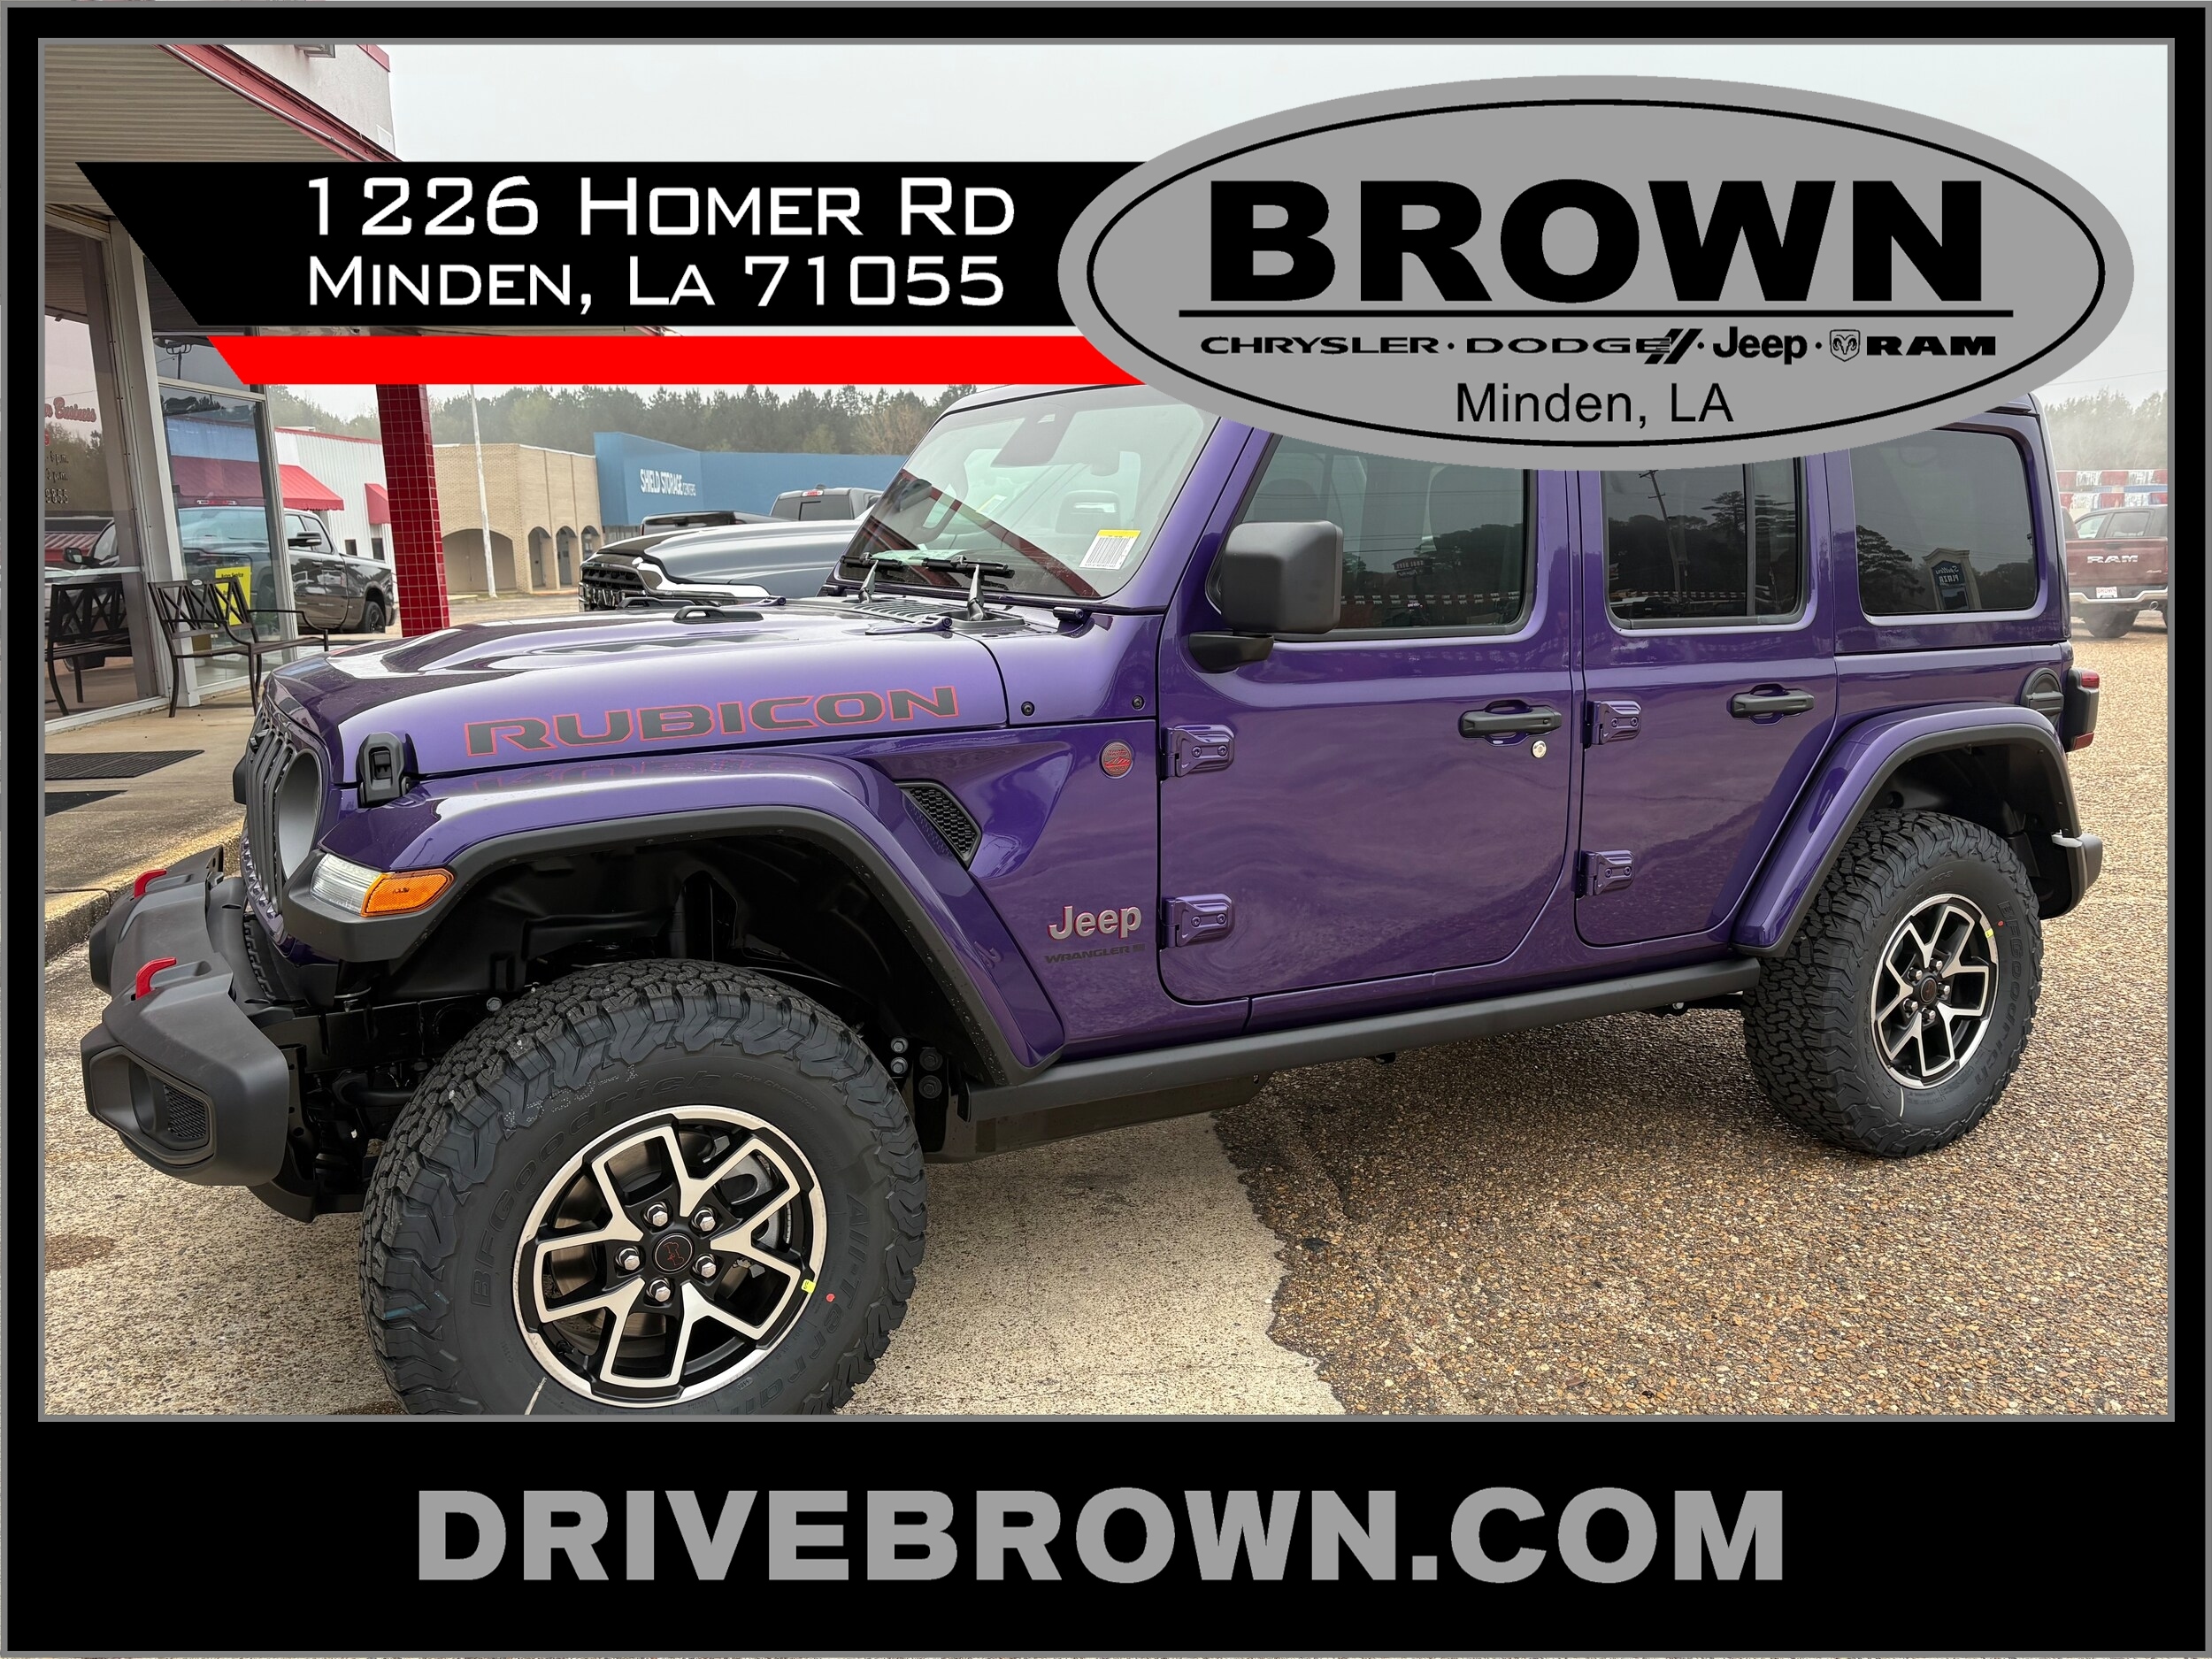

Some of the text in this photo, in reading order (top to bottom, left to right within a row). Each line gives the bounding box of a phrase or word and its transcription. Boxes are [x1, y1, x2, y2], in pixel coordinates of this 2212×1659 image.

[640, 468, 661, 494] SHIELD
[660, 471, 684, 495] STORAGE
[2086, 555, 2139, 564] RAM
[464, 685, 959, 757] RUBICON
[1048, 905, 1142, 941] Jeep
[1045, 945, 1130, 964] WRANGLER
[470, 1070, 723, 1308] BFGoodrich
